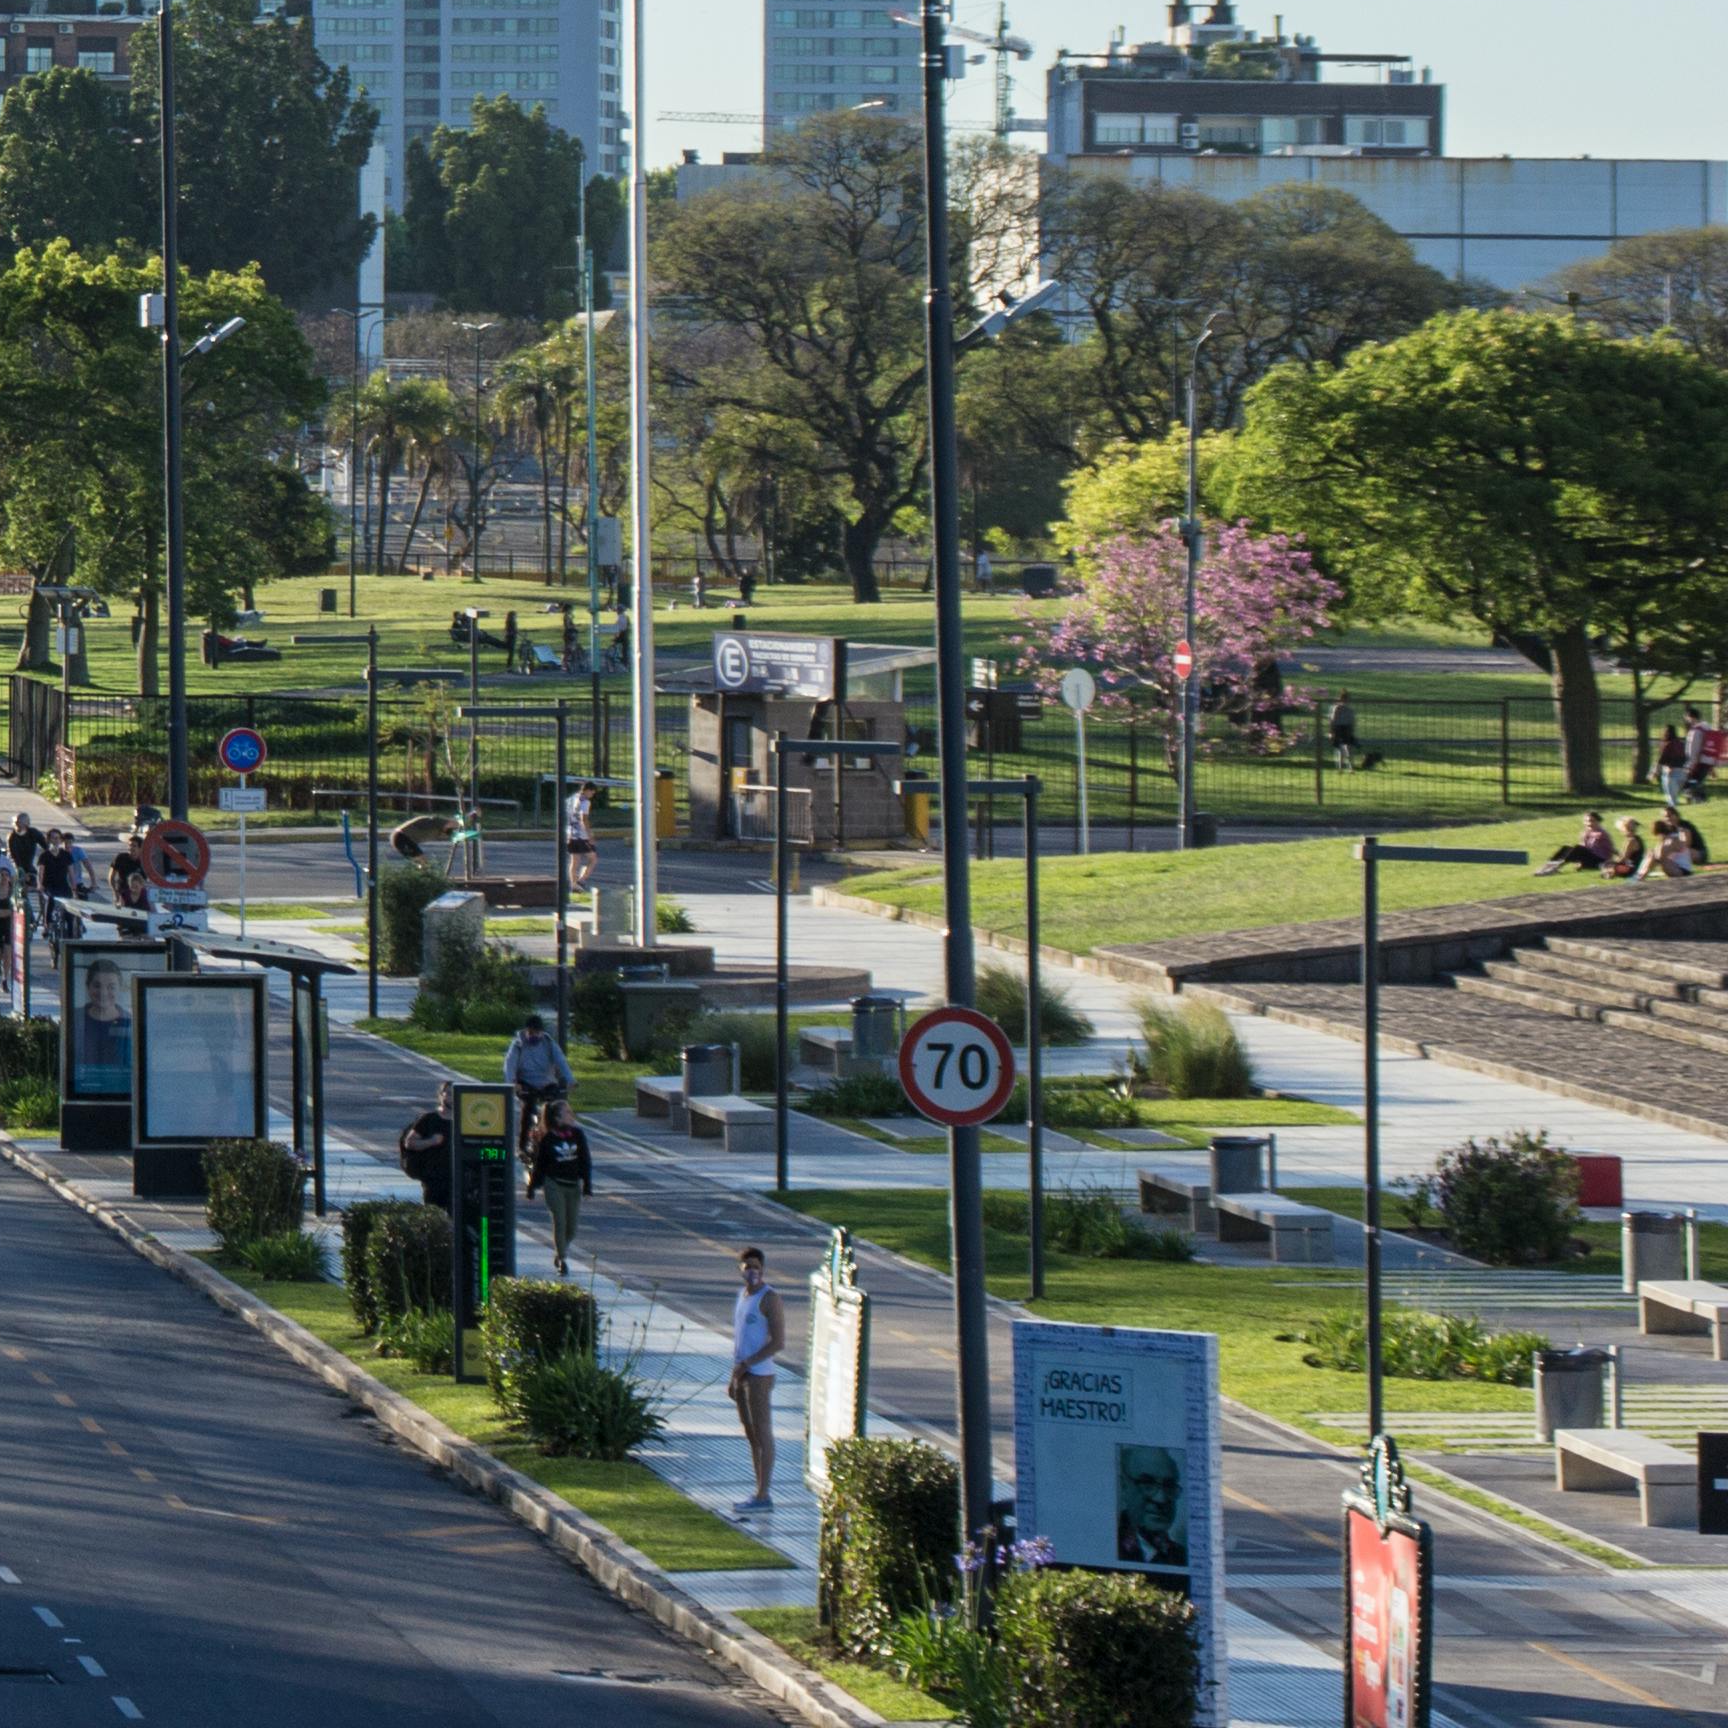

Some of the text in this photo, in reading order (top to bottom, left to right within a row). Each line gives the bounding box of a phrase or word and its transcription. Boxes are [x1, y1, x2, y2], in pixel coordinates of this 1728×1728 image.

[724, 647, 742, 678] E
[927, 1043, 990, 1090] 70
[1045, 1370, 1122, 1394] ¡GRACIAS
[1040, 1398, 1126, 1422] MAESTRO!
